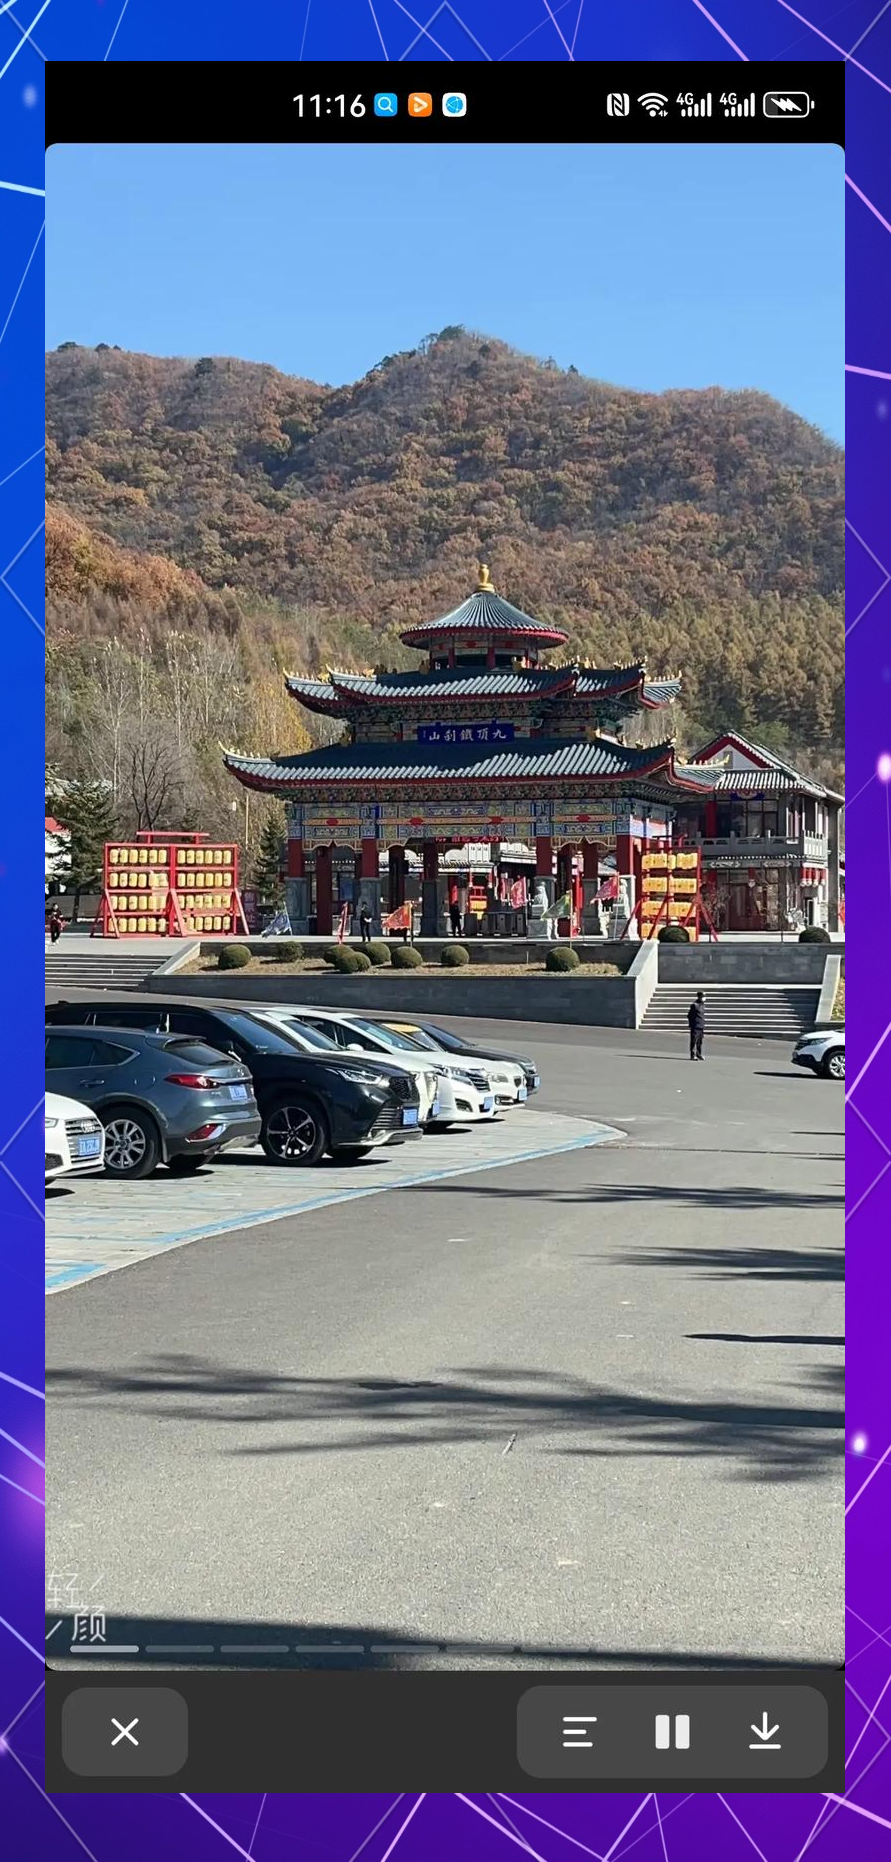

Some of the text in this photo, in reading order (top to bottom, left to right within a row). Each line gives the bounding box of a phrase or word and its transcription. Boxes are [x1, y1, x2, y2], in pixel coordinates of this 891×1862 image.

[293, 93, 366, 117] 11:16
[676, 92, 694, 105] 4G
[719, 92, 738, 105] 4G
